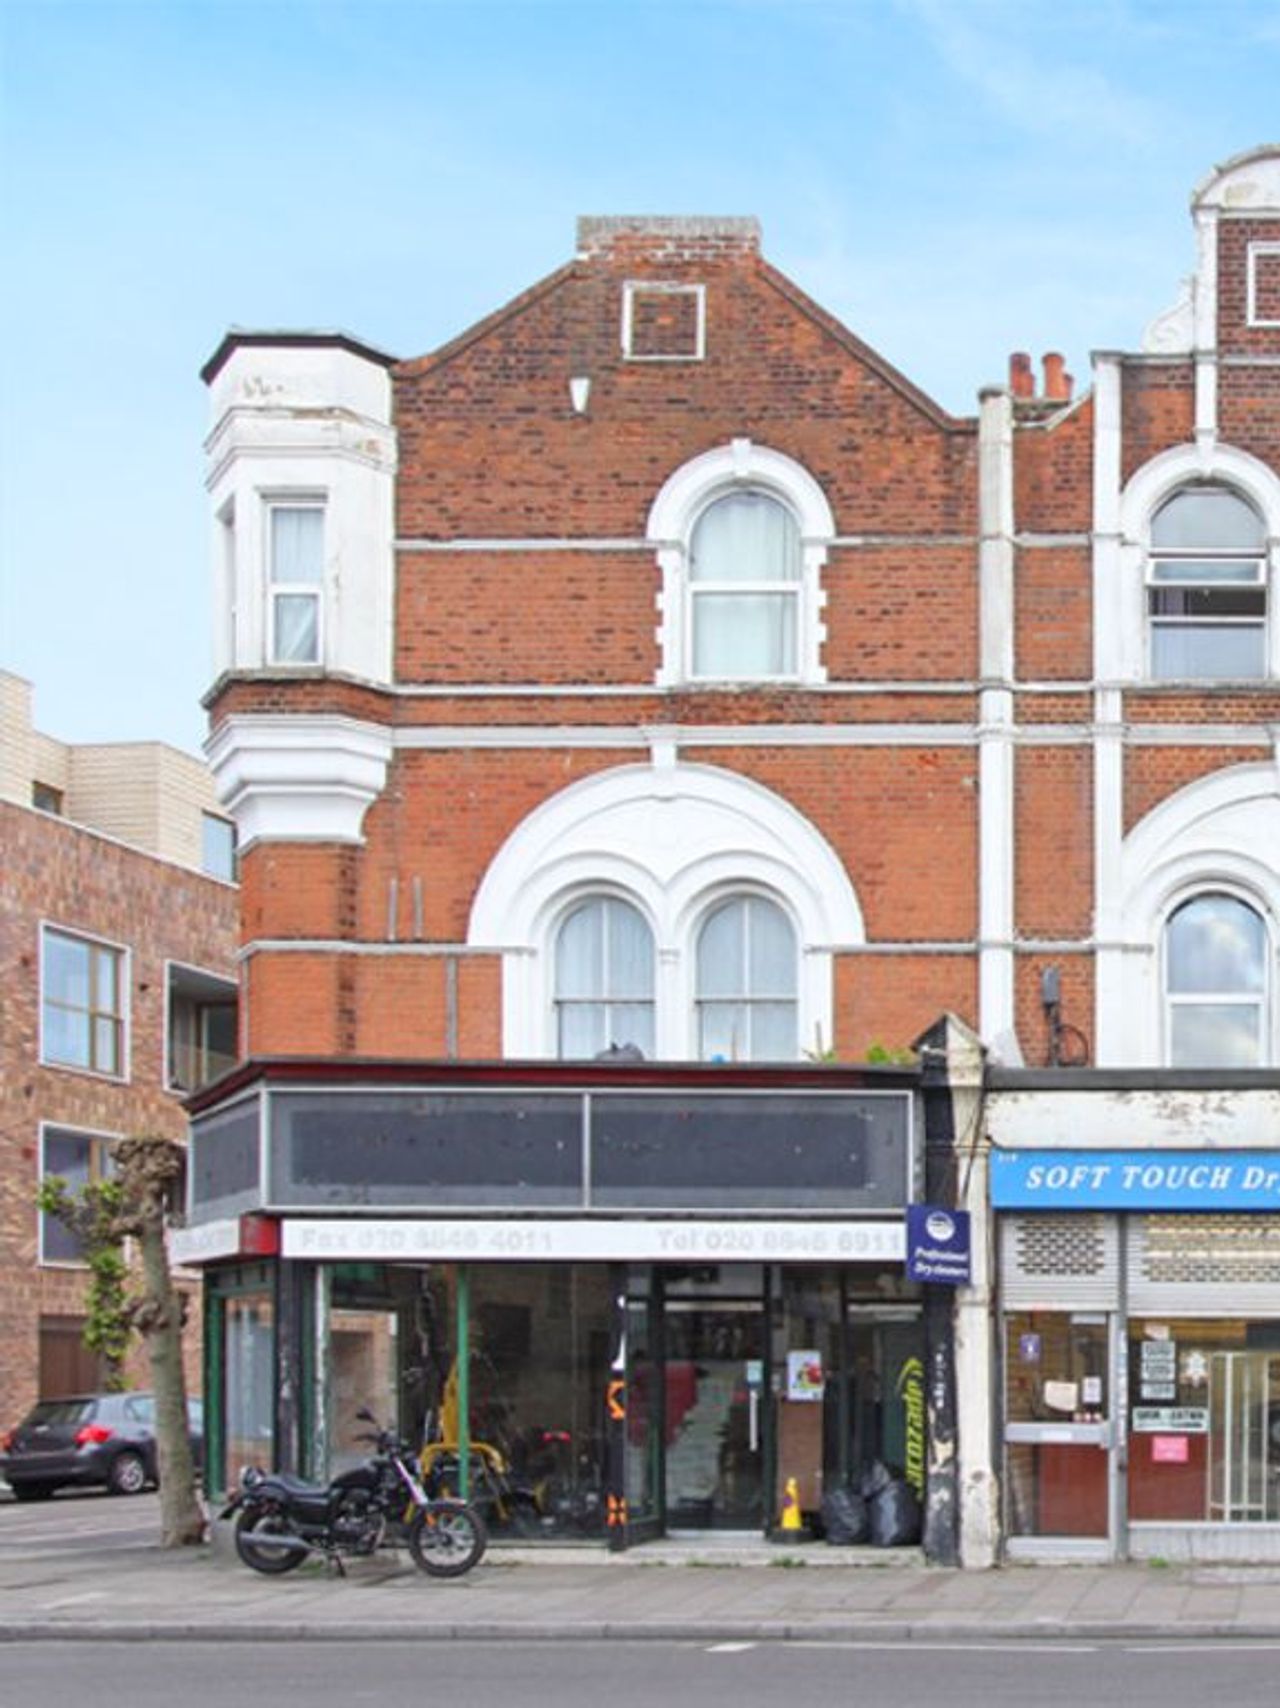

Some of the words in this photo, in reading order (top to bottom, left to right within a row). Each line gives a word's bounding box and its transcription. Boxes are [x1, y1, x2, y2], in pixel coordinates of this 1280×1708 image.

[1025, 1165, 1110, 1190] SOFT
[1122, 1165, 1233, 1190] TOUCH
[301, 1228, 347, 1249] Fax
[657, 1229, 696, 1251] Tel
[704, 1229, 754, 1251] 020
